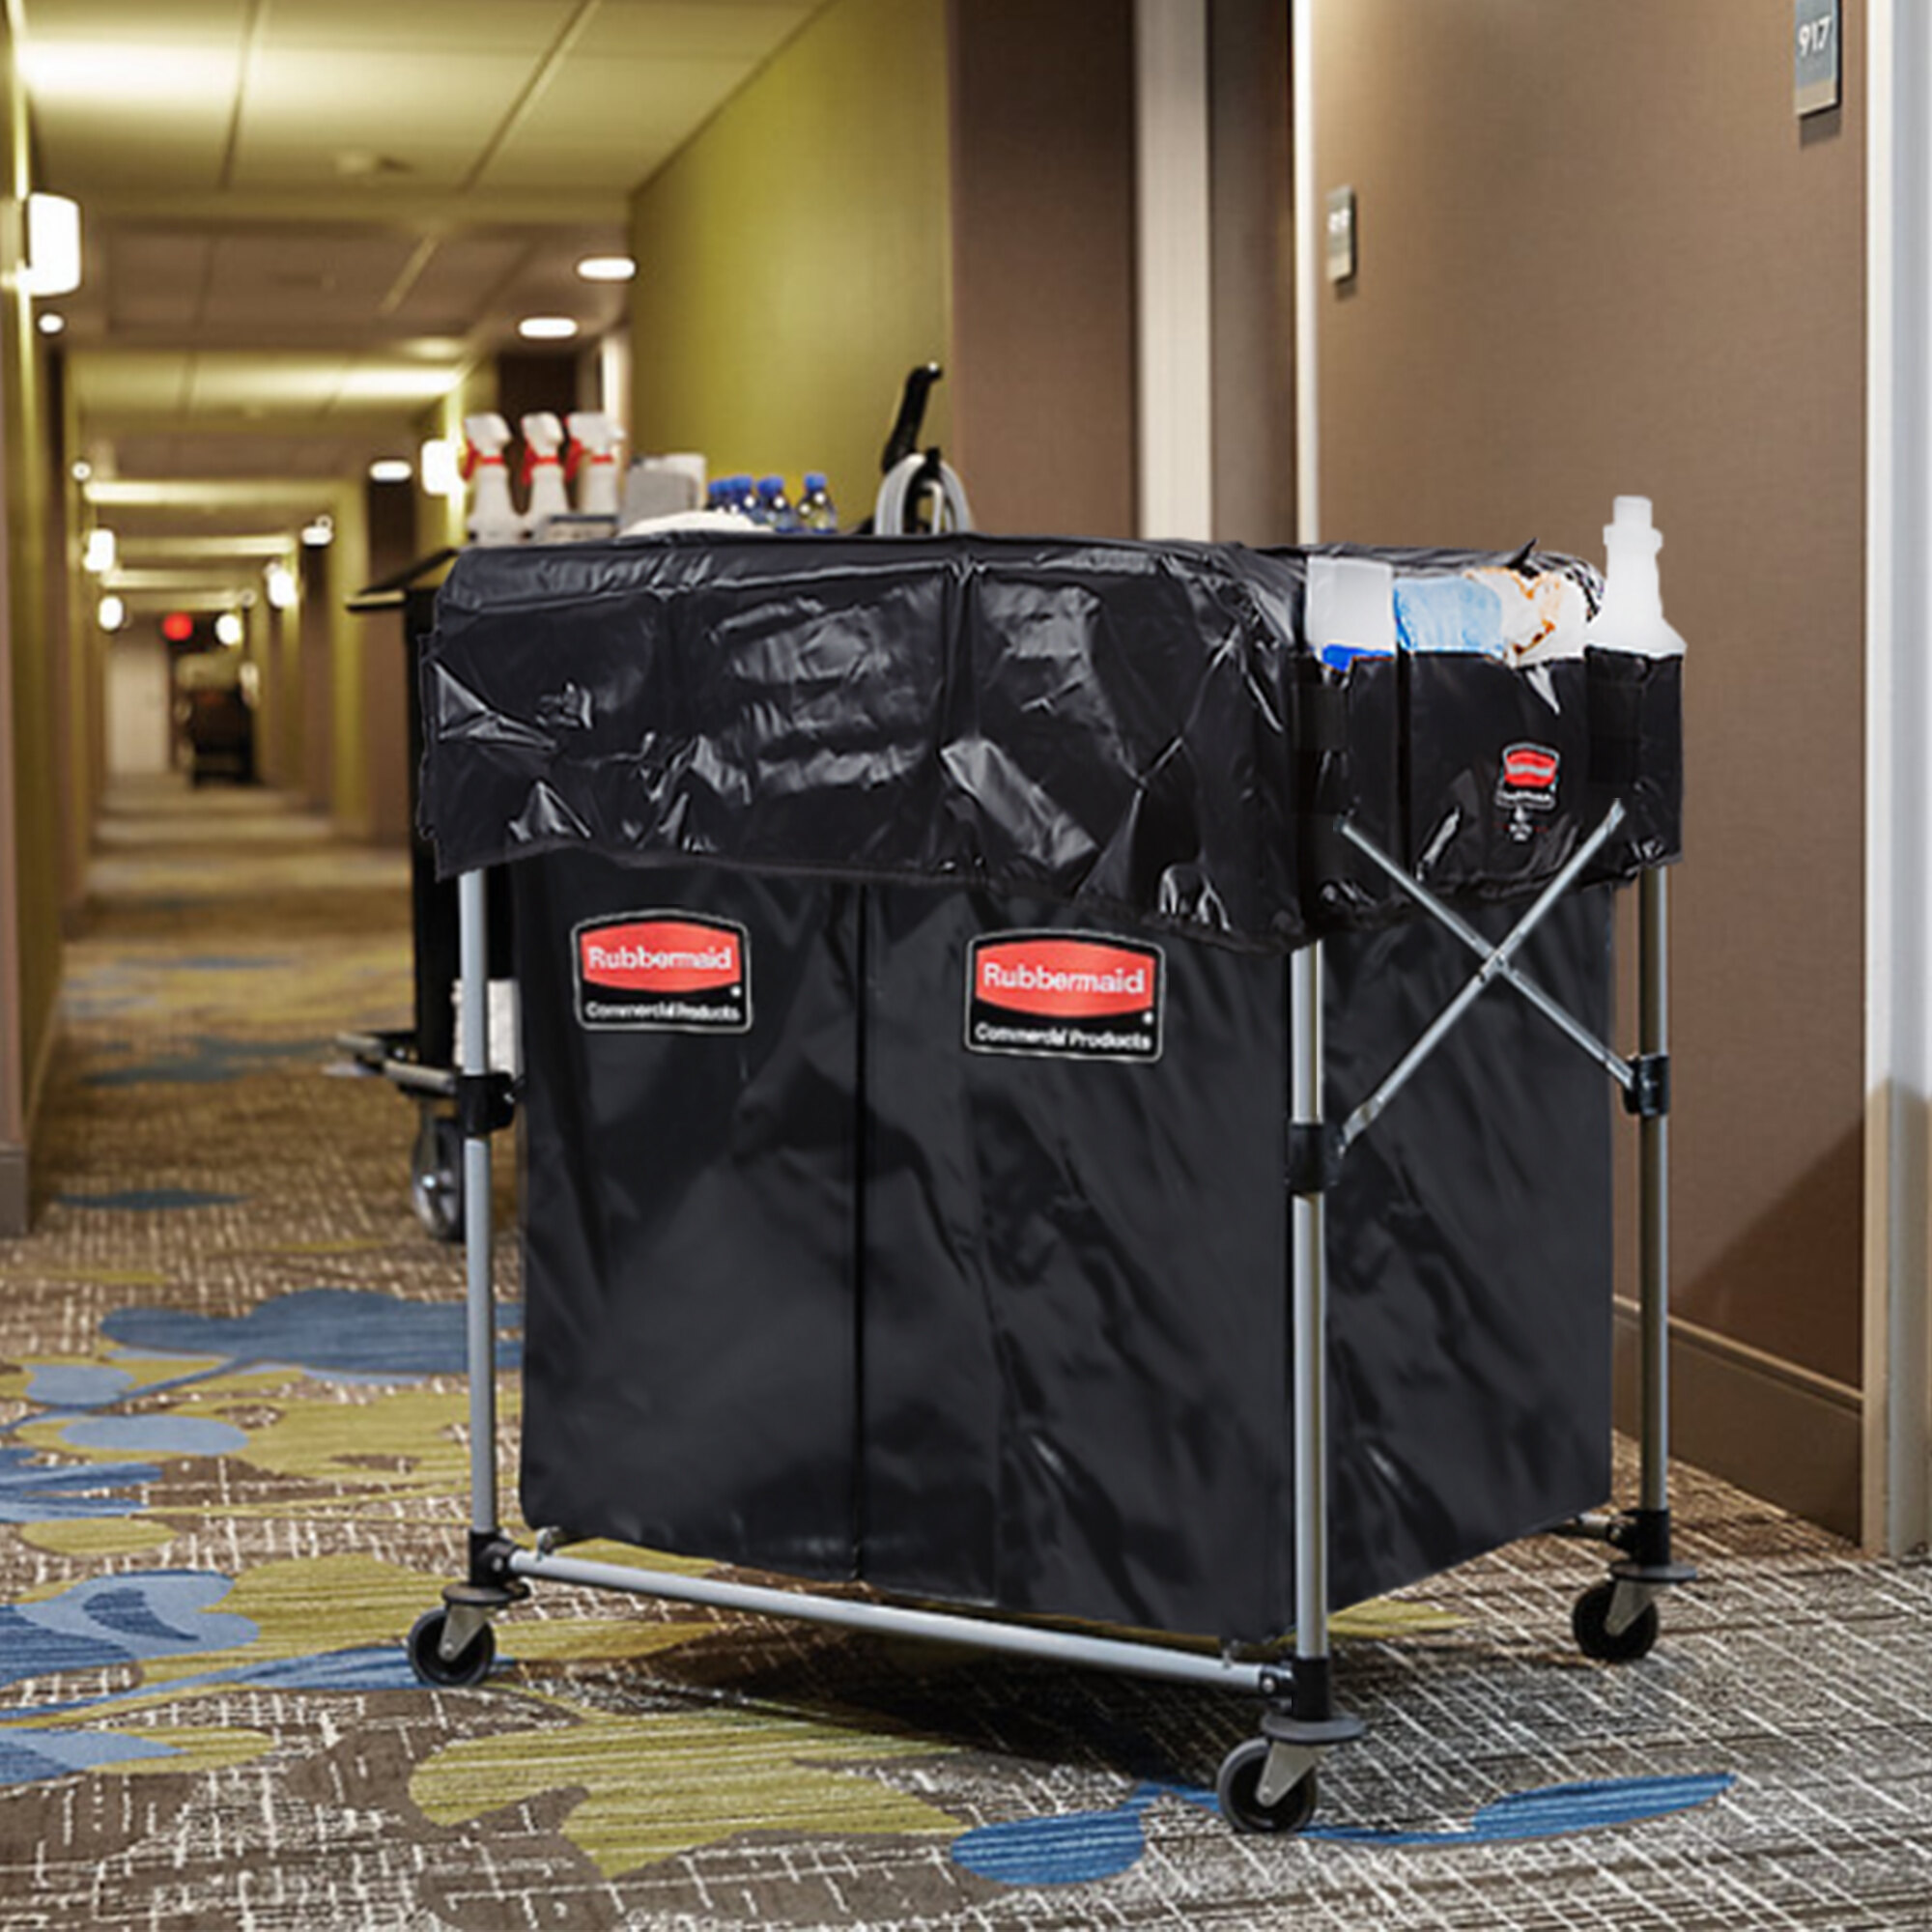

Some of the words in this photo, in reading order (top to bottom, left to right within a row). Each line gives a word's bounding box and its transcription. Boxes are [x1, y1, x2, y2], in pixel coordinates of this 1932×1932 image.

[1799, 15, 1831, 57] 917
[587, 946, 732, 970] Rubbermaid
[983, 963, 1145, 994] Rubbermaid
[1069, 1029, 1151, 1051] Products
